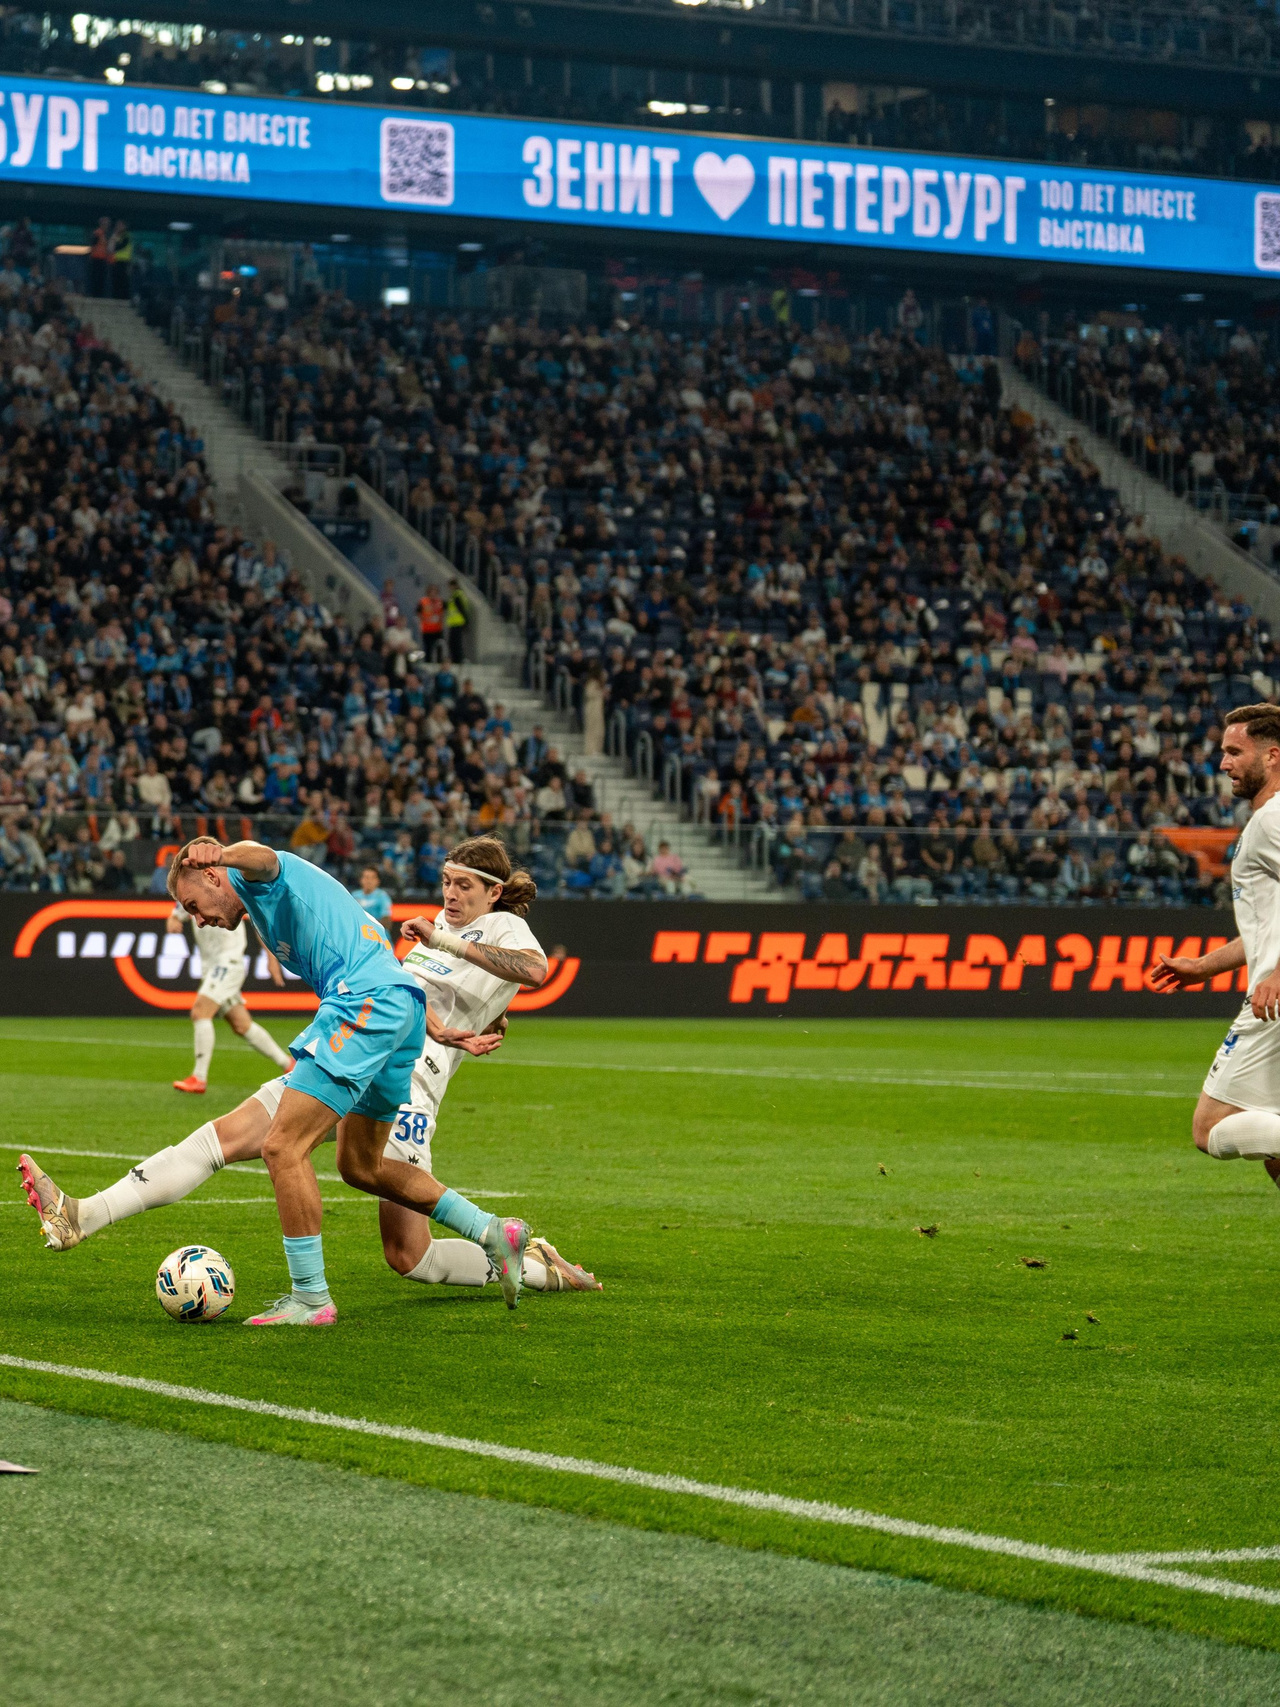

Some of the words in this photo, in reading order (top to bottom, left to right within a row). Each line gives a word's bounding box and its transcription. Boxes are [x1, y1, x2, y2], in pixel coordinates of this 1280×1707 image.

[125, 102, 165, 138] 100
[173, 106, 215, 141] ЛЕТ
[224, 110, 311, 150] ВМЕСТЕ
[124, 143, 251, 184] ВЫСТАВКА
[522, 135, 681, 218] ЗЕНИТ
[768, 156, 1027, 245] ПЕТЕРБУРГ
[1040, 180, 1075, 212] 100
[1081, 183, 1116, 214] ЛЕТ
[1123, 187, 1197, 222] ВМЕСТЕ
[1039, 218, 1146, 255] ВЫСТАВКА
[394, 1110, 428, 1146] 38
